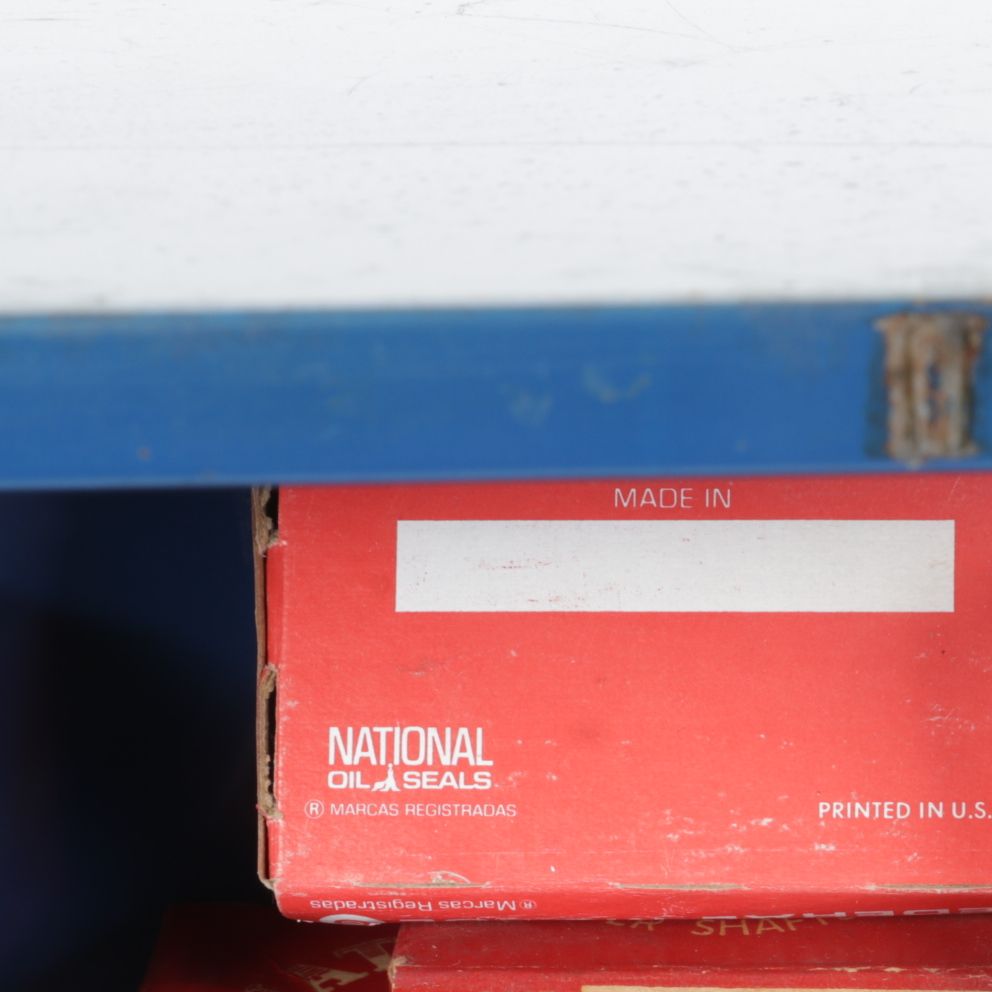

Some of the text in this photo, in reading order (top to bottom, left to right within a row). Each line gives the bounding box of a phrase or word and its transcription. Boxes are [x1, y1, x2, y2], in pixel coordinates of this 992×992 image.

[613, 487, 732, 509] MADE IN
[328, 726, 493, 766] NATIONAL
[327, 770, 492, 790] OIL SEALS
[330, 801, 399, 817] MARCAS
[405, 801, 517, 817] REGISTRADAS
[818, 801, 911, 819] PRINTED
[919, 801, 944, 818] IN
[310, 898, 432, 912] Registradas
[439, 898, 516, 911] Marcas
